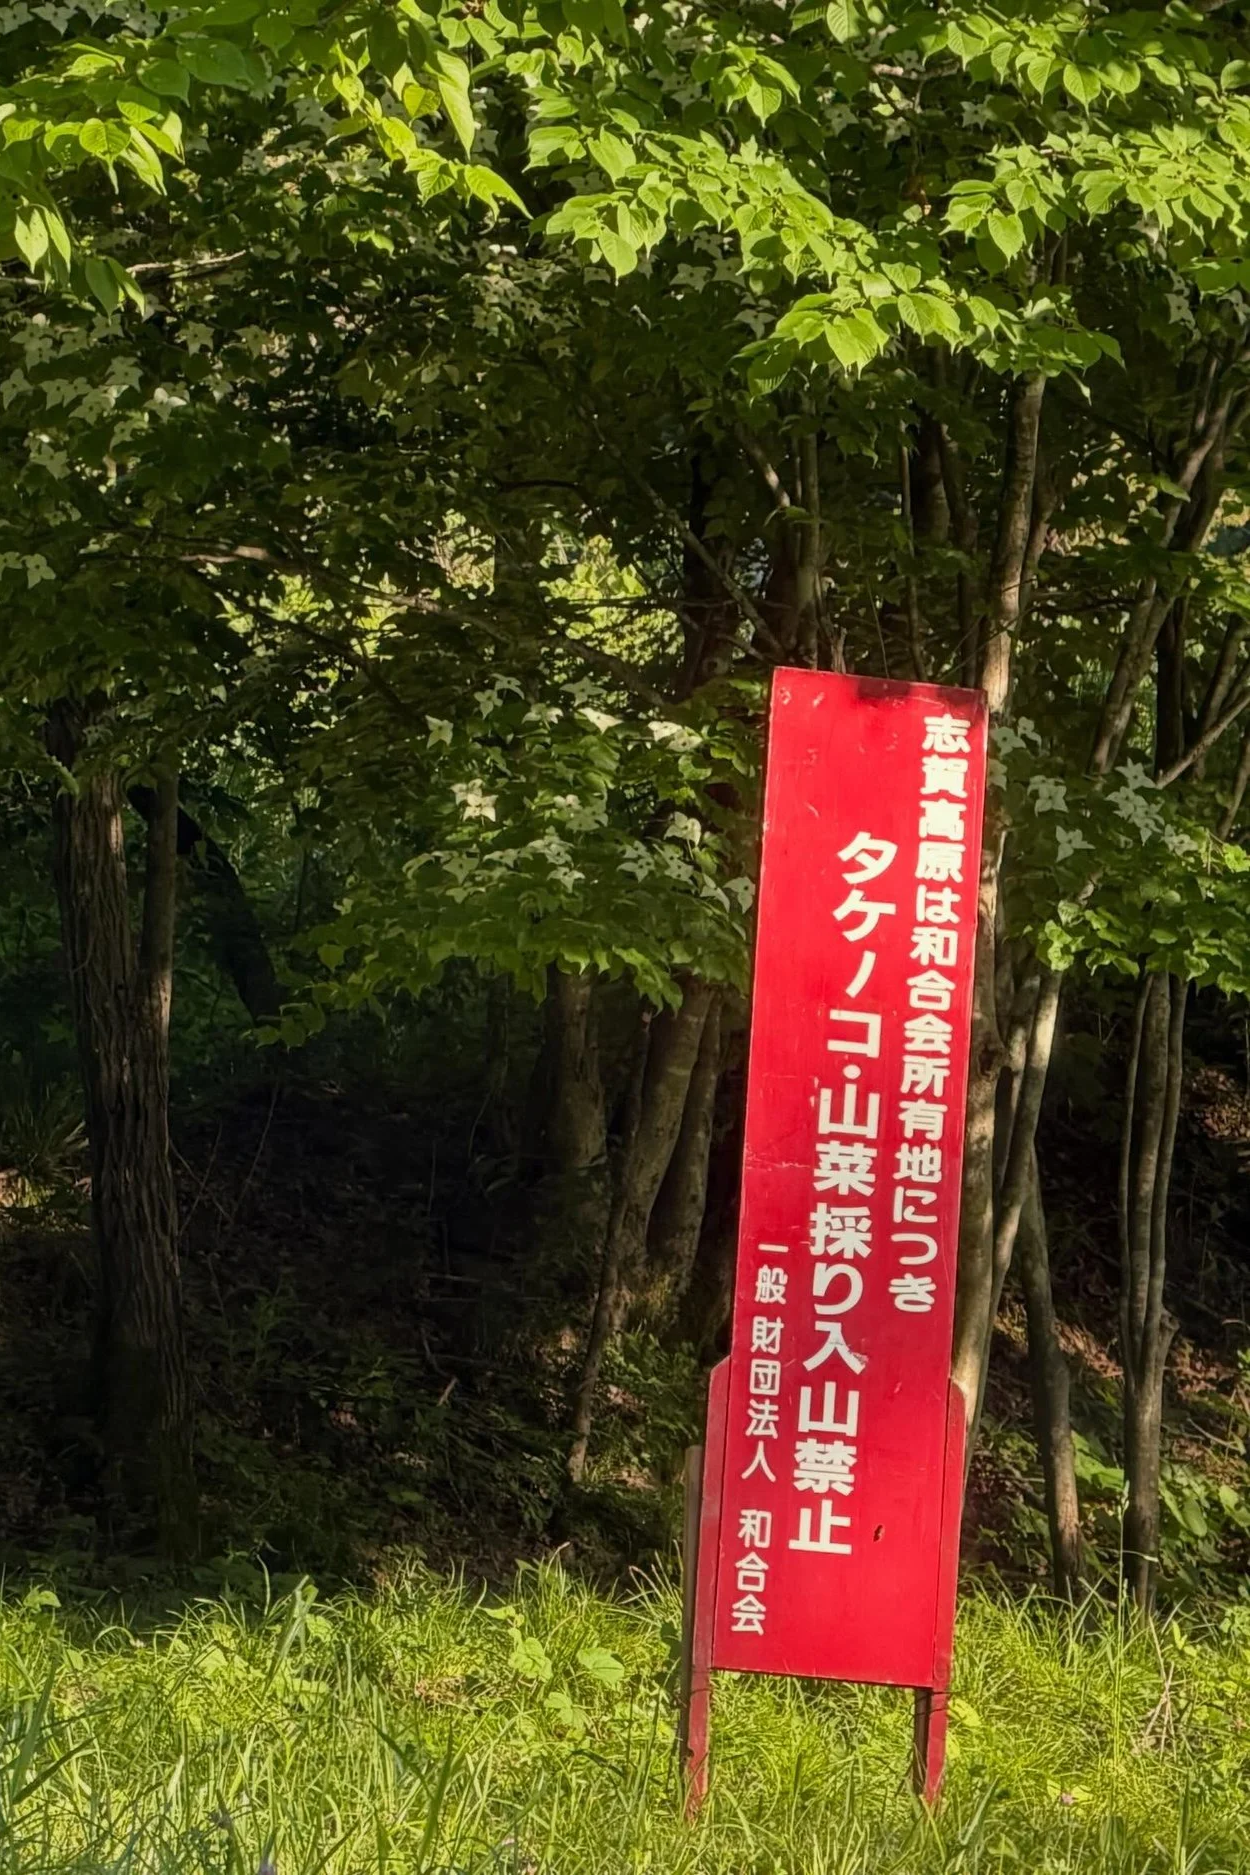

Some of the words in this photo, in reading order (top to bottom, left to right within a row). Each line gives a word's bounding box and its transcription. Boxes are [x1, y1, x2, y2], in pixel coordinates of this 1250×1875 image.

[788, 831, 899, 1556] タケノコ・山菜採り入山禁止
[888, 713, 972, 1314] 志賀高原は和合会所有地につき
